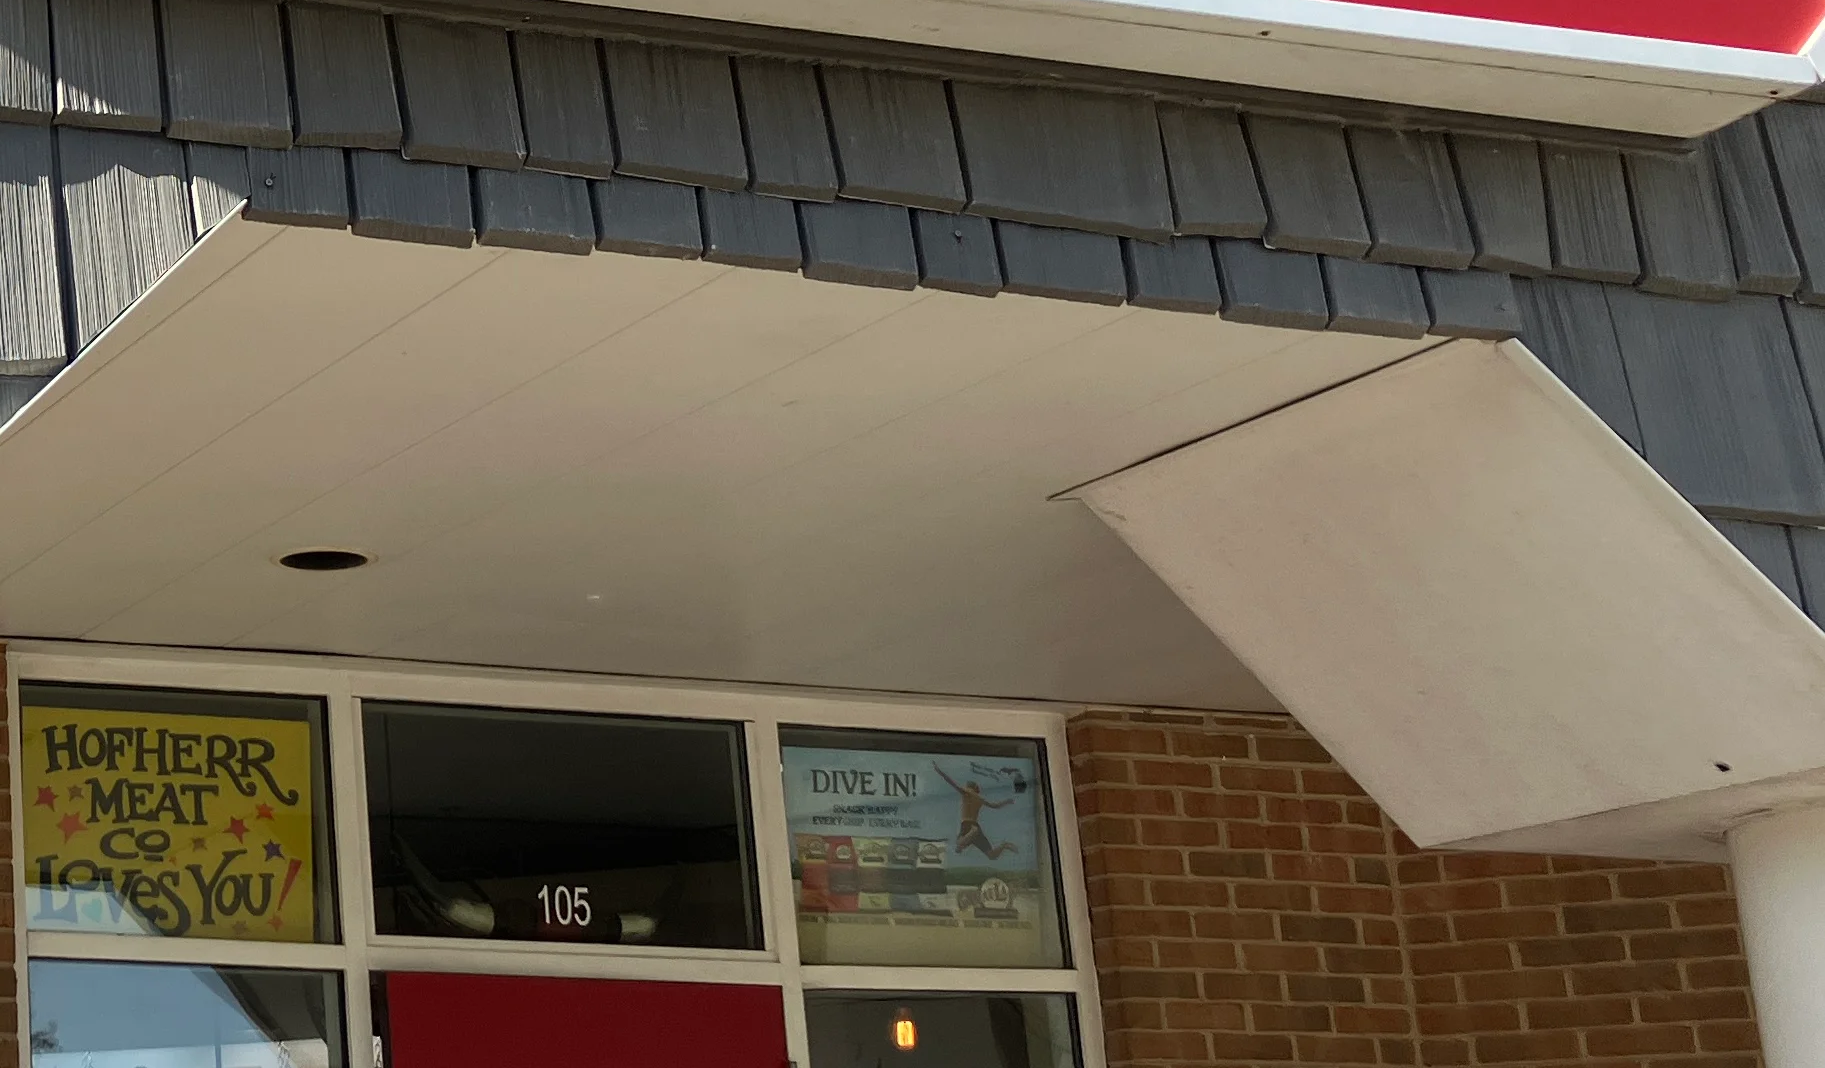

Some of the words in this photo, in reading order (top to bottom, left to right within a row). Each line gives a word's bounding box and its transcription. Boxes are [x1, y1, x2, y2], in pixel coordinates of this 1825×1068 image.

[42, 724, 299, 806] HOFHERR
[811, 770, 877, 795] DIVE
[883, 773, 917, 797] IN!
[85, 778, 219, 826] MEAT
[538, 885, 591, 925] 105
